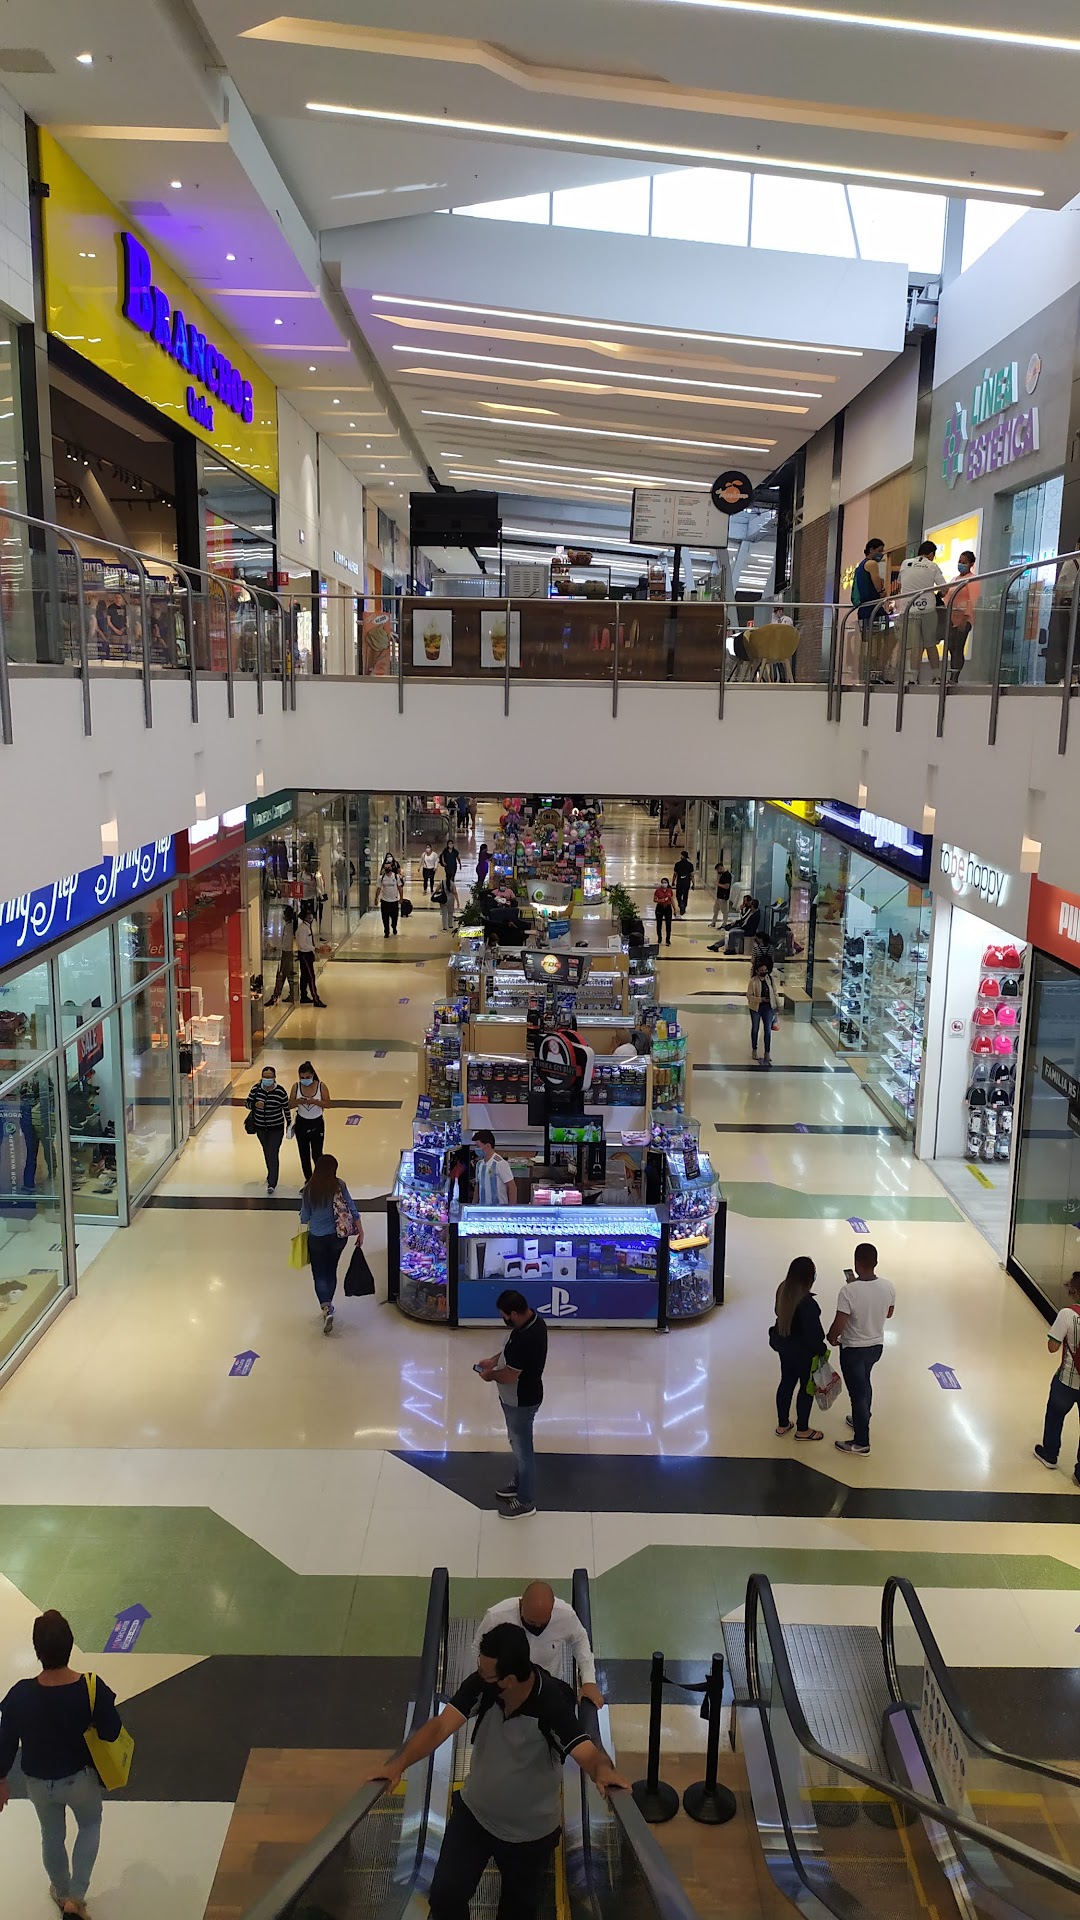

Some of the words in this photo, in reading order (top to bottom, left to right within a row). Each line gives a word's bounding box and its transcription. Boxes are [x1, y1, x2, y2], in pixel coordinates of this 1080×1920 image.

[121, 232, 253, 423] BRANCHOS
[971, 362, 1018, 427] LÍNEA
[966, 407, 1040, 482] ESTÉTICA
[966, 852, 1005, 907] happy
[81, 1027, 98, 1056] SALE
[1044, 1063, 1068, 1092] FAMILIA
[1067, 1082, 1077, 1098] RS
